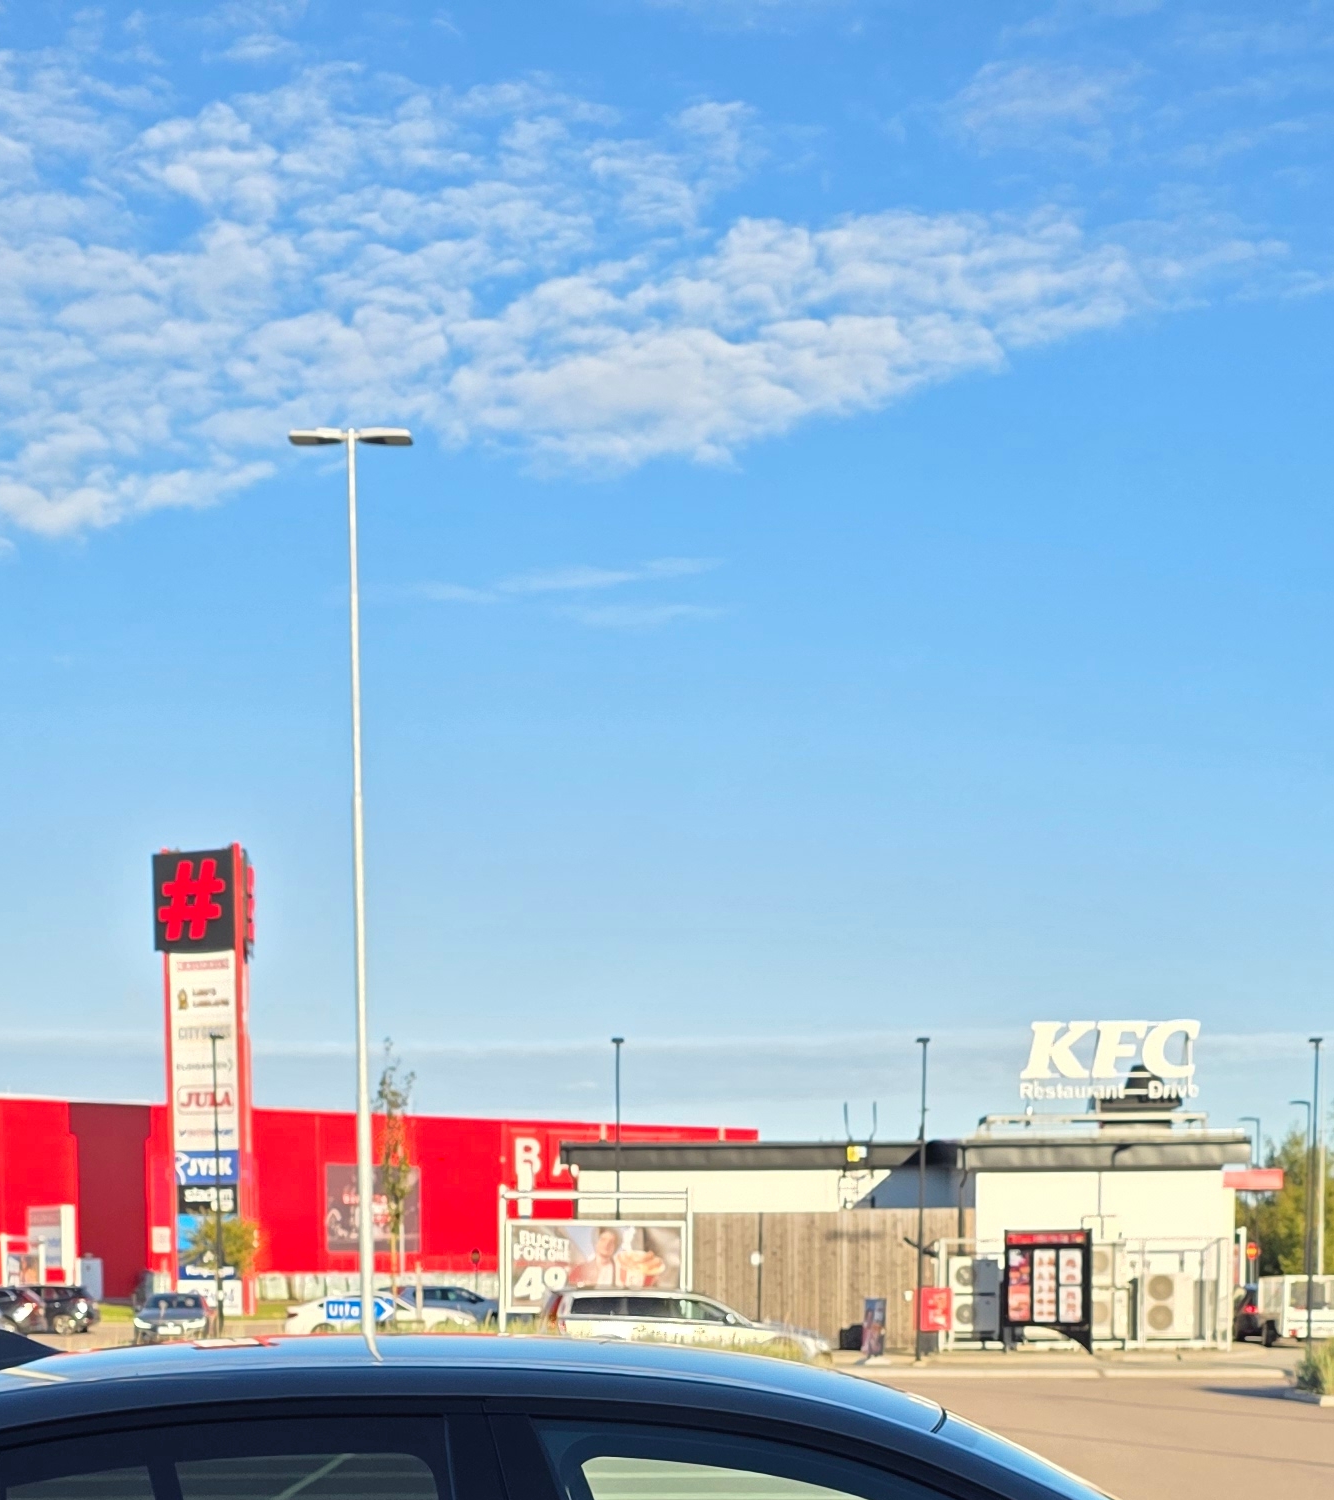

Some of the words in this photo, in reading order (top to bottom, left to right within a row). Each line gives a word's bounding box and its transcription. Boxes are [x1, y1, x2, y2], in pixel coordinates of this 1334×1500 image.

[1020, 1019, 1201, 1079] KFC
[180, 1091, 231, 1107] JULA
[1020, 1080, 1125, 1099] Restaurant
[1148, 1080, 1199, 1099] Drive
[187, 1157, 233, 1176] JYSK
[519, 1230, 570, 1249] BUCKET
[513, 1243, 546, 1262] FOR
